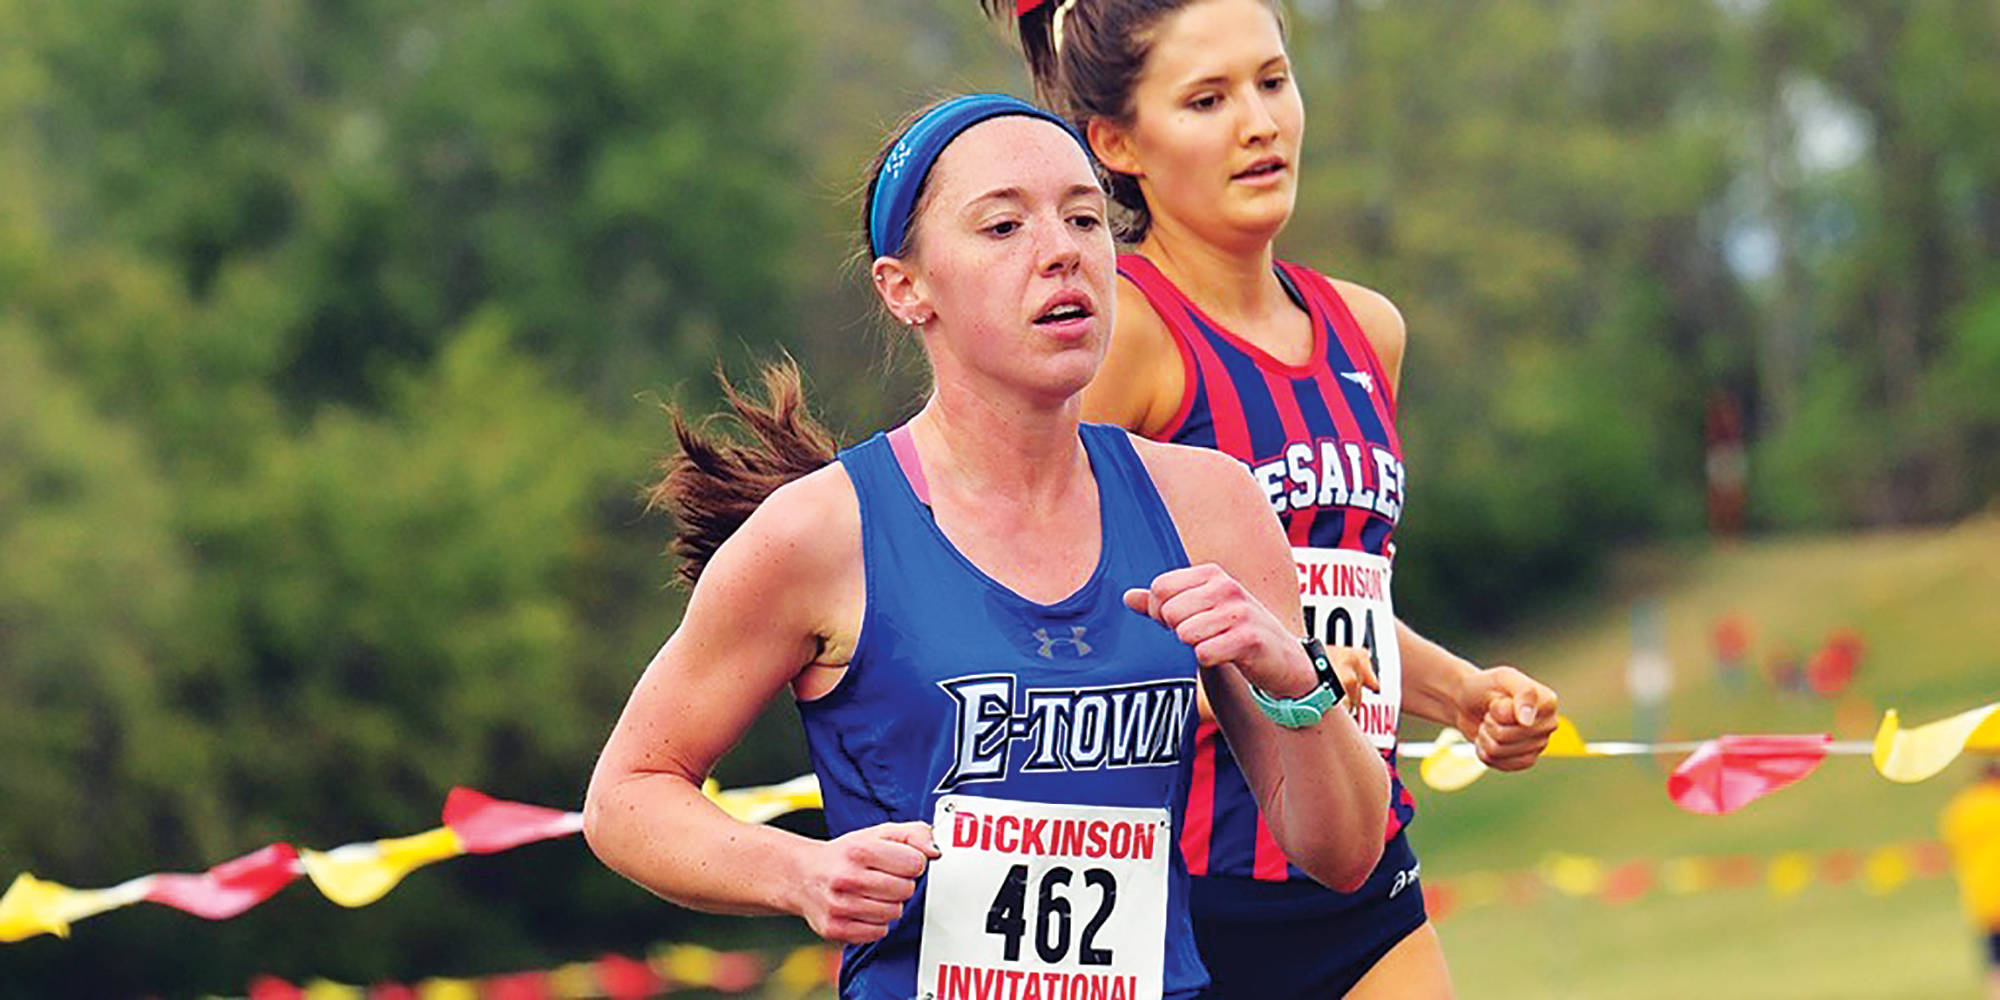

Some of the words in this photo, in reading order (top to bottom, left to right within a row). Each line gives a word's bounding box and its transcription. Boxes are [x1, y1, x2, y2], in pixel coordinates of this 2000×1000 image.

[1252, 442, 1404, 524] ESALE
[932, 672, 1197, 794] E-TOWN
[952, 811, 1155, 860] DICKINSON
[985, 864, 1117, 966] 462
